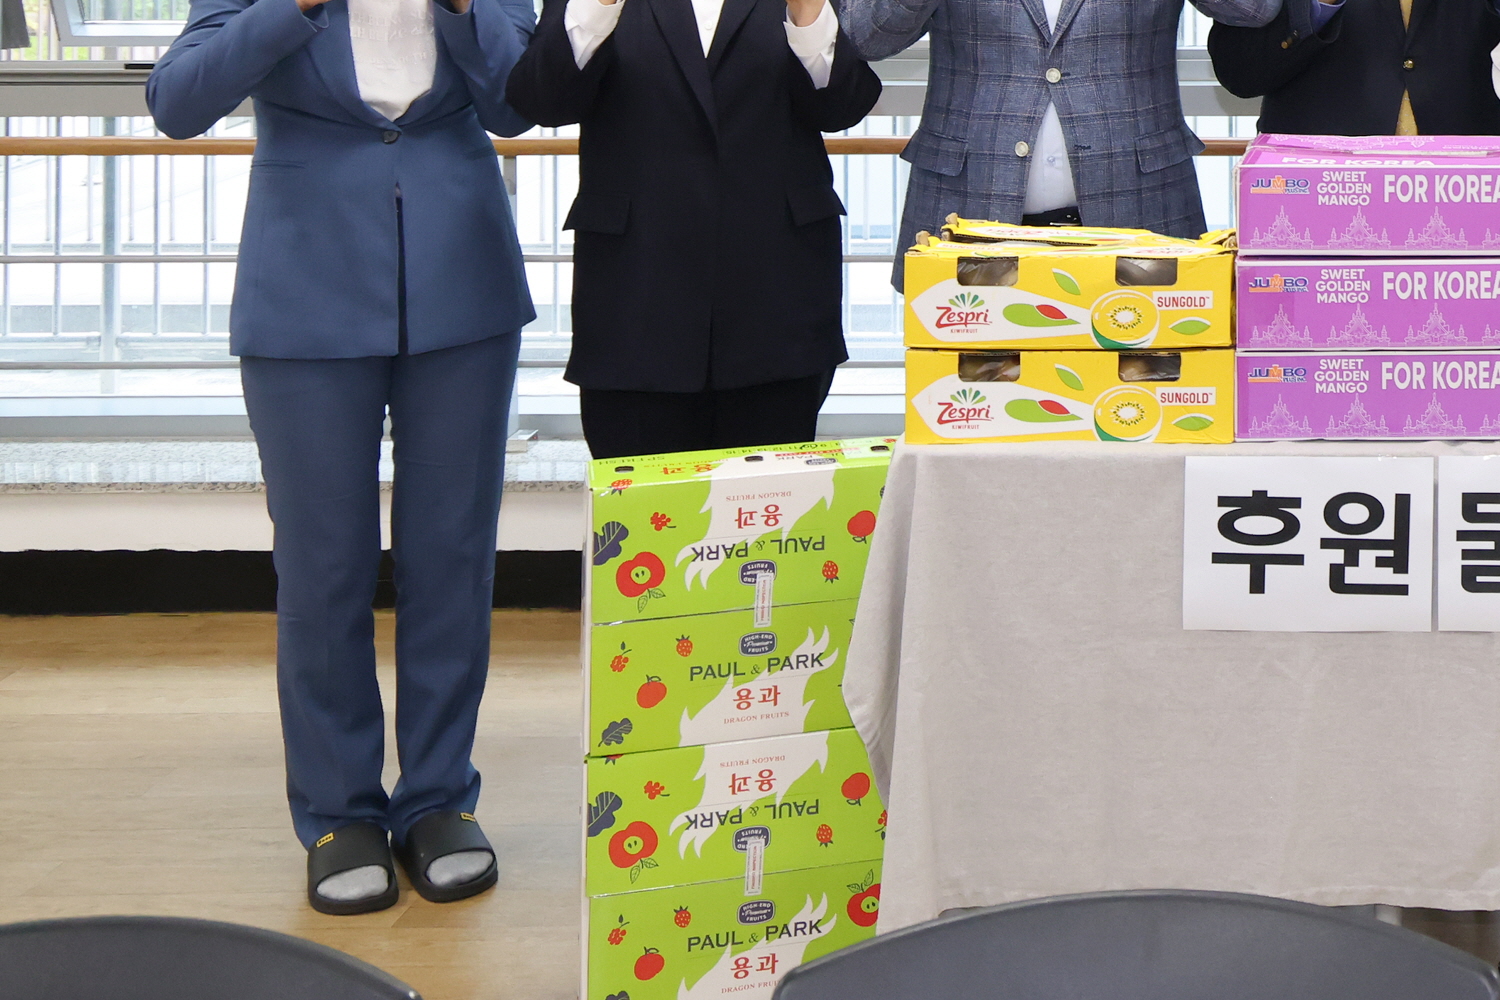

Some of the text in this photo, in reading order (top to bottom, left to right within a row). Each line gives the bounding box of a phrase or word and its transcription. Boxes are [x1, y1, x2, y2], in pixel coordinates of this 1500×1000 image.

[1281, 156, 1436, 167] FOR KOREA
[1251, 176, 1309, 189] JUMBO
[1322, 171, 1367, 182] SWEET
[1316, 183, 1372, 194] GOLDEN
[1383, 174, 1429, 203] FOR
[1317, 194, 1371, 206] MANGO
[1320, 268, 1366, 280] SWEET
[1249, 275, 1309, 288] JUMBO
[1315, 280, 1371, 292] GOLDEN
[1382, 271, 1428, 300] FOR
[1157, 296, 1207, 308] SUNGOLD
[1316, 292, 1369, 304] MANGO
[935, 306, 991, 329] Zespri
[1319, 358, 1364, 370] SWEET
[1248, 366, 1307, 378] JUMBO
[1314, 370, 1370, 381] GOLDEN
[1381, 361, 1426, 390] FOR
[1315, 382, 1368, 394] MANGO
[1160, 392, 1210, 404] SUNGOLD
[936, 402, 992, 425] Zespri
[725, 490, 792, 502] DRAGON FRUITS
[734, 504, 783, 529] 용과
[691, 535, 825, 562] PAUL & PARK
[1210, 489, 1412, 596] 후원
[689, 652, 825, 681] PAUL & PARK
[732, 684, 781, 711] 용과
[723, 711, 790, 725] DRAGON FRUITS
[719, 755, 786, 768] DRAGON FRUITS
[728, 768, 777, 795] 용과
[684, 798, 820, 831] PAUL & PARK
[687, 918, 823, 952] PAUL & PARK
[730, 953, 779, 980] 용과
[721, 980, 780, 994] DRAGON FRUI
